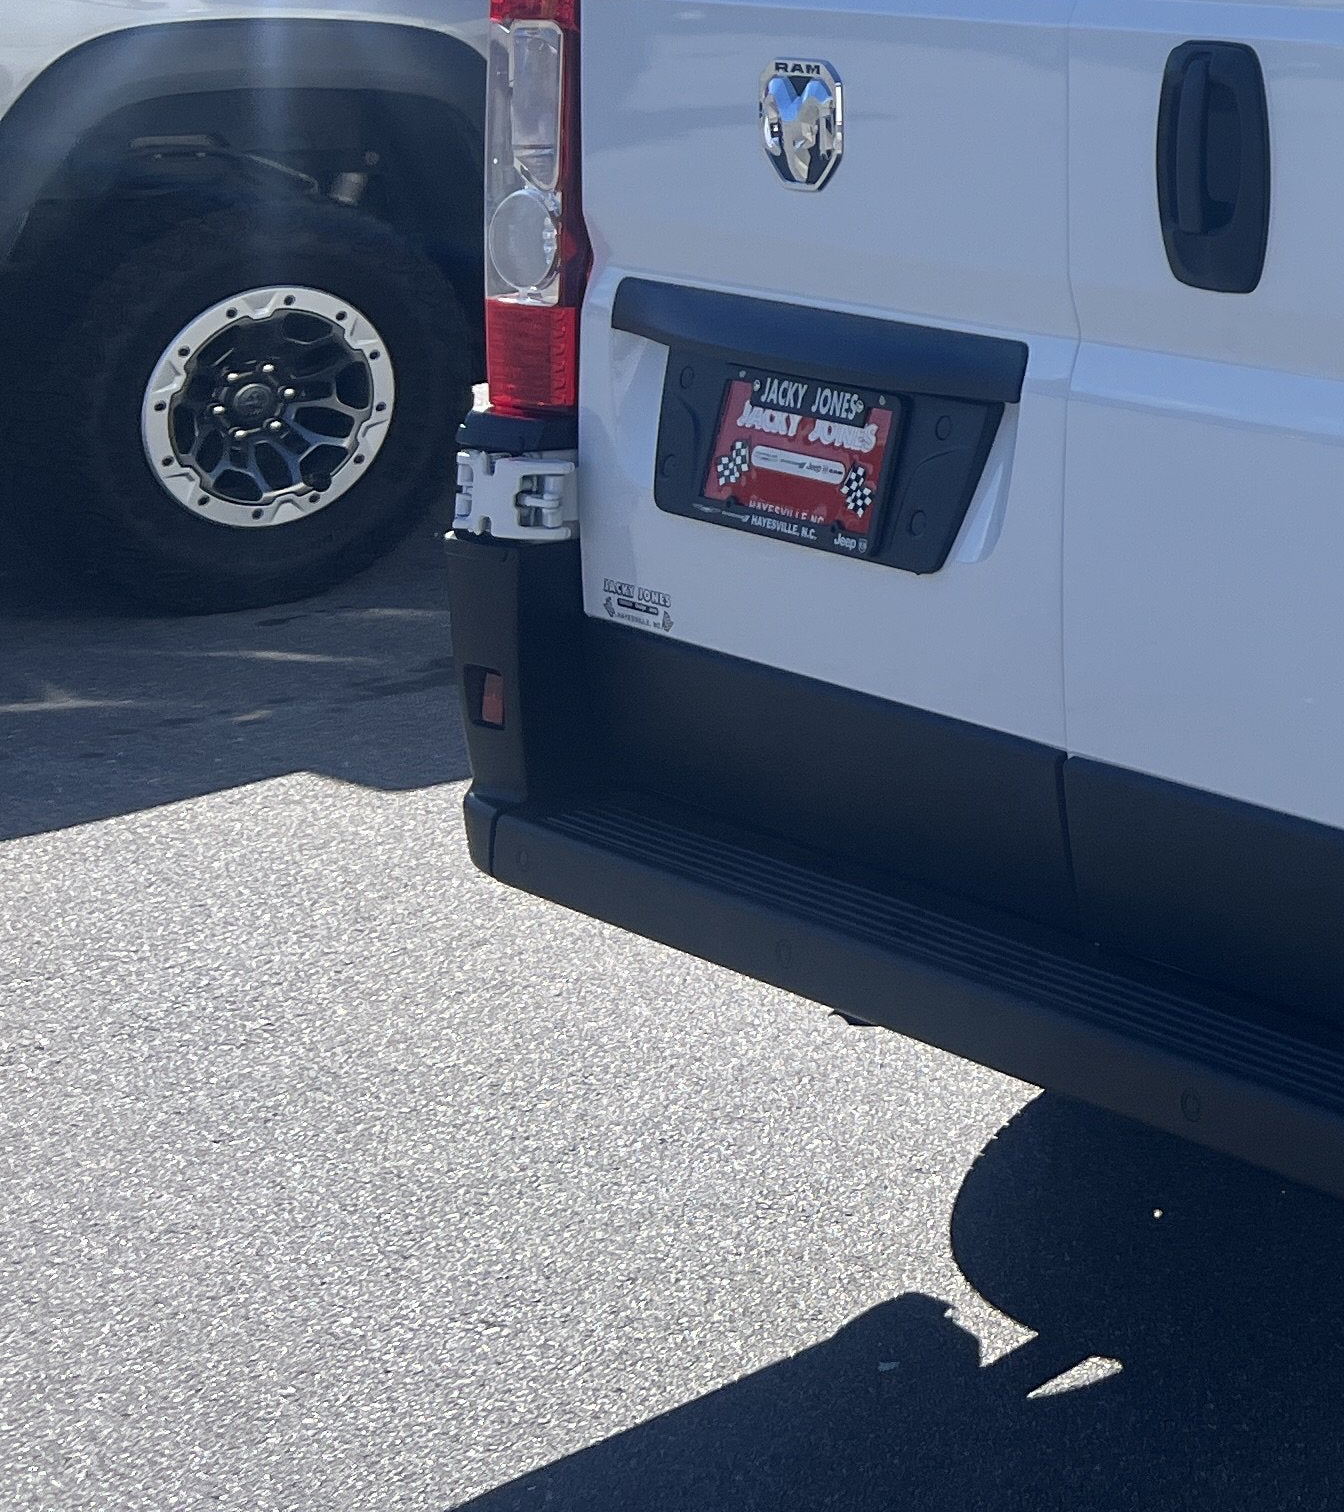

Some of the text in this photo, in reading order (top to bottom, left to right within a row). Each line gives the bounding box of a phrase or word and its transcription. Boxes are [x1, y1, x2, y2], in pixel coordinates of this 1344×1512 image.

[774, 61, 821, 75] RAM
[760, 377, 859, 420] JACKY JONES
[751, 514, 800, 537] HAYESVILLE,
[833, 532, 857, 551] Jeep
[638, 587, 672, 609] JONES
